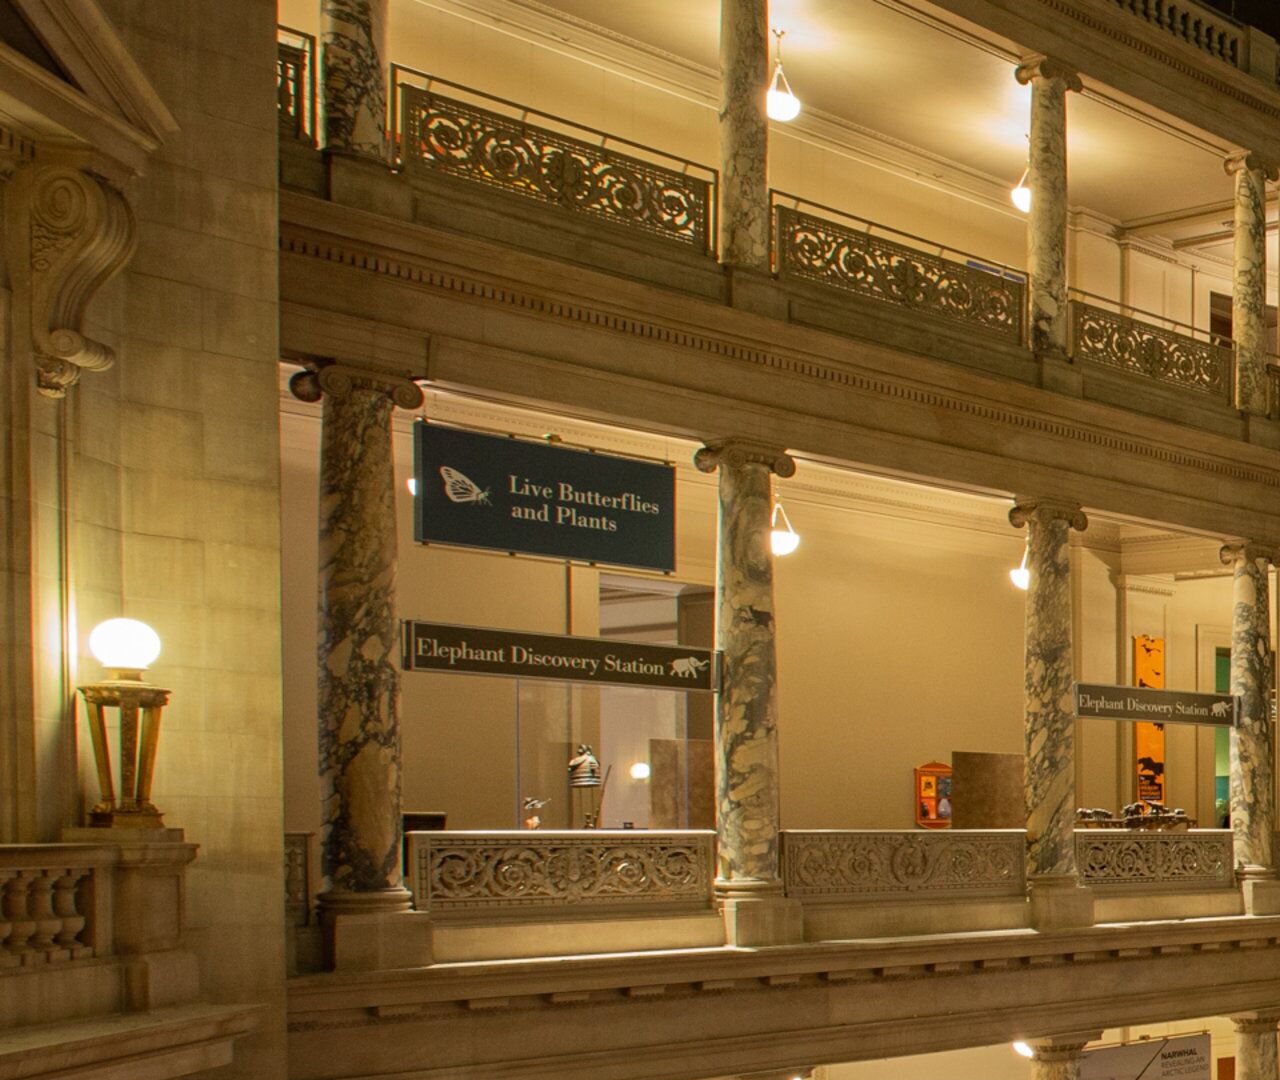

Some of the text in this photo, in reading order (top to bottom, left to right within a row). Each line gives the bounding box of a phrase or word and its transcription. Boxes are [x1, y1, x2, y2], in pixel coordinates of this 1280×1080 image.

[509, 475, 660, 514] Live Butterflies
[511, 503, 617, 531] and Plants
[416, 636, 665, 676] Elephant Discovery Station
[1079, 694, 1208, 717] Elephant Discovery Station
[1161, 1048, 1198, 1060] NARWHAL
